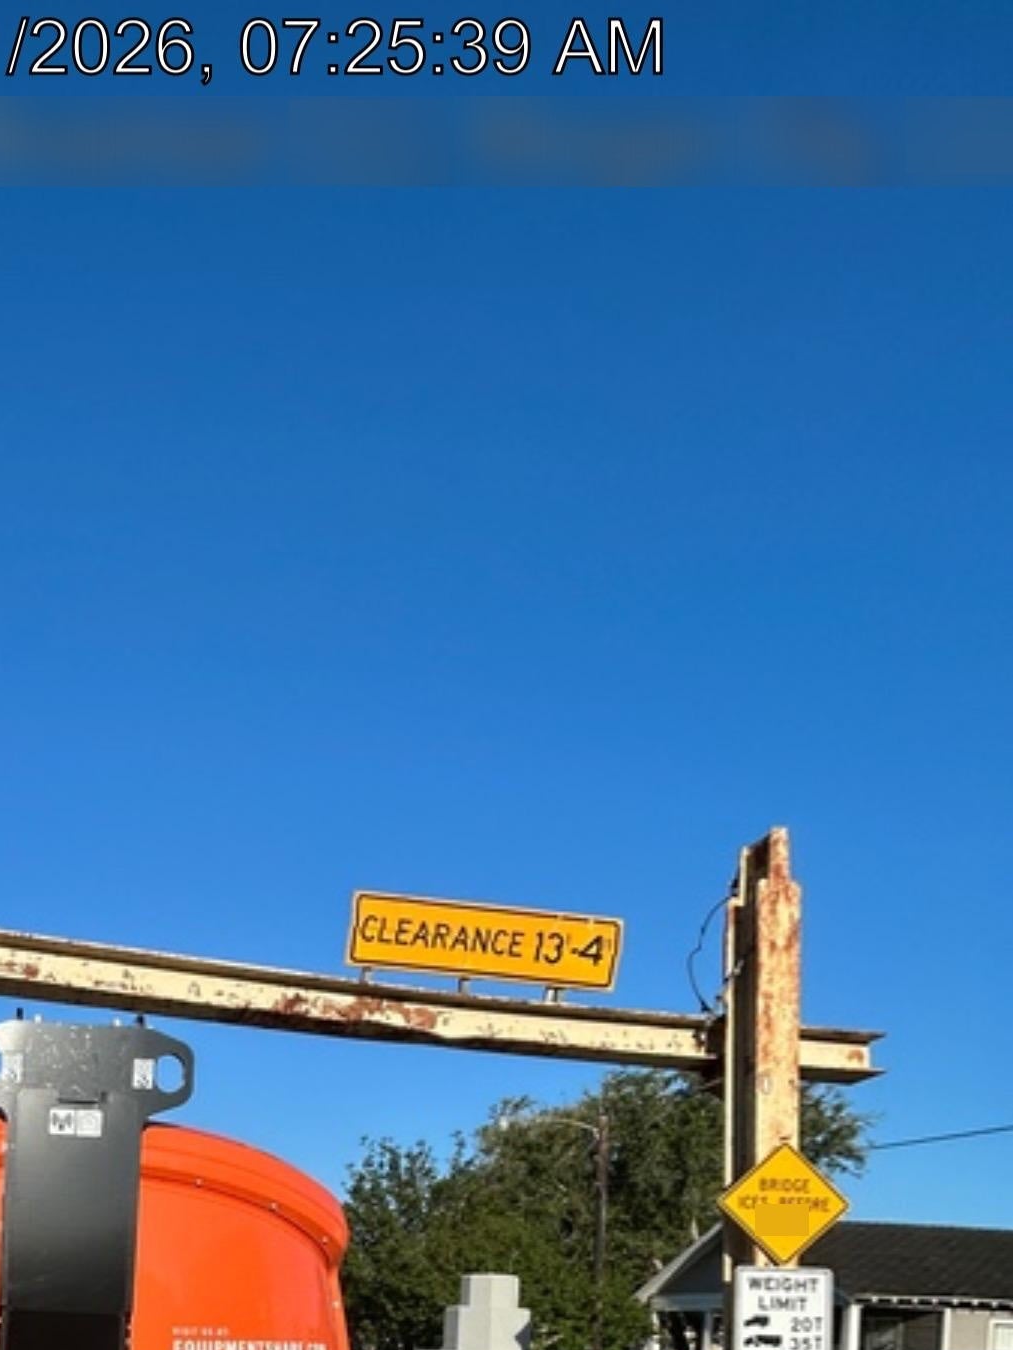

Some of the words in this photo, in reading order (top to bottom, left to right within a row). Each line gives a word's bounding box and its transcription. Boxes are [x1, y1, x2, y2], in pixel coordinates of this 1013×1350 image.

[360, 915, 525, 959] CLEARANCE
[759, 1177, 811, 1194] BRIDGE
[747, 1277, 819, 1293] WEIGHT
[757, 1296, 808, 1312] LIMIT
[790, 1316, 823, 1333] 20T
